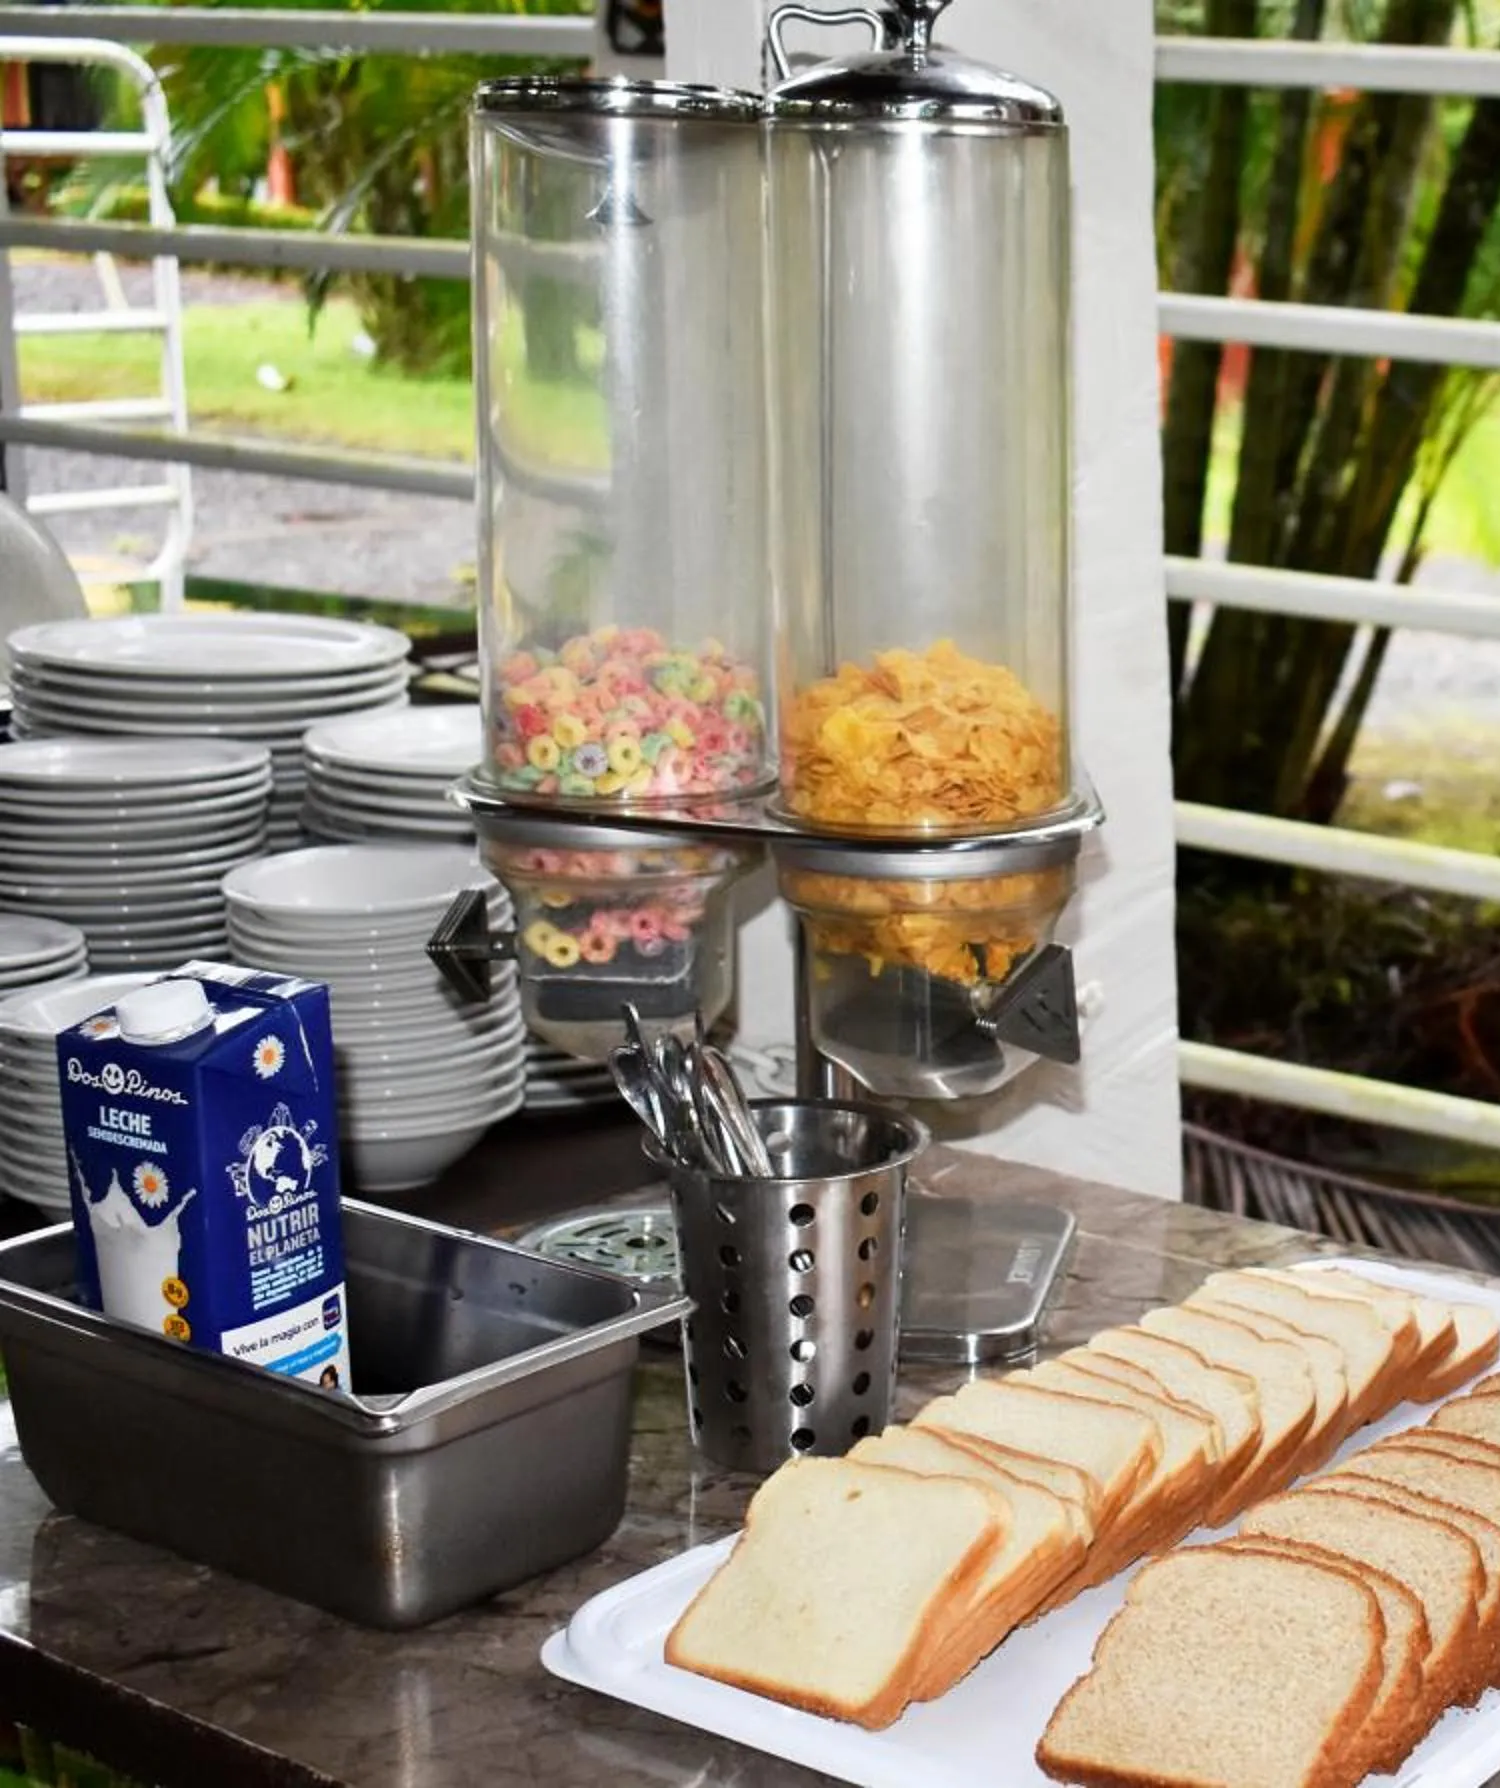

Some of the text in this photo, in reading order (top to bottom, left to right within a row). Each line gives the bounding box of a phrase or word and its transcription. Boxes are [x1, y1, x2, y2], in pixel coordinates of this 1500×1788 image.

[67, 1057, 189, 1105] Dos Pinos
[99, 1105, 151, 1136] LECHE
[247, 1203, 319, 1249] NUTRIR
[249, 1227, 321, 1267] EL PLANETA
[232, 1343, 258, 1356] Vive
